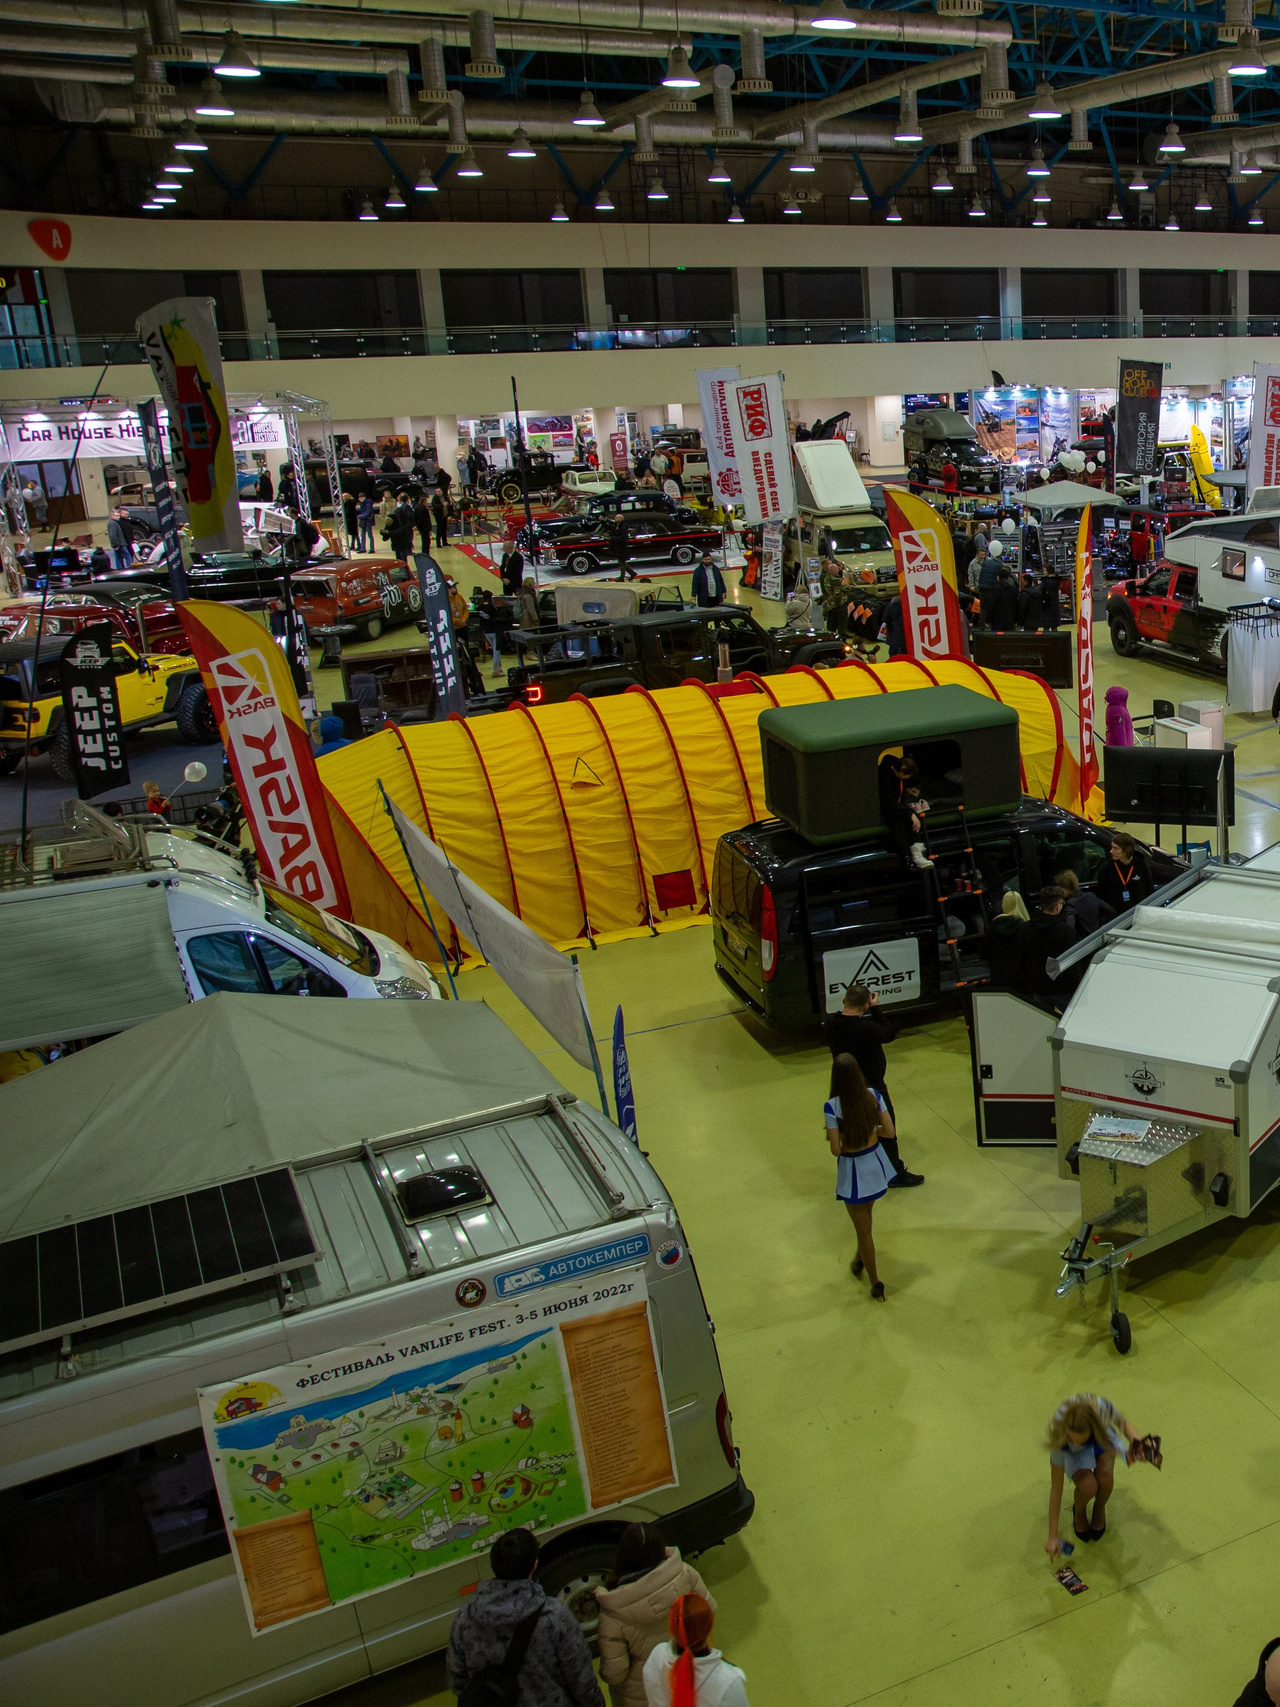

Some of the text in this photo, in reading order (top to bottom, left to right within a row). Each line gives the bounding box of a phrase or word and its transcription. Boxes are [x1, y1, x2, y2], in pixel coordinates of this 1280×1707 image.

[51, 229, 62, 248] A
[1122, 377, 1154, 389] ROAD
[1122, 387, 1147, 398] CLUB
[1124, 369, 1147, 381] OFF
[253, 423, 278, 433] HOUSE
[710, 381, 721, 433] тюнинг-центр
[742, 389, 766, 437] РИФ
[18, 422, 170, 442] CAR HOUSE HISO
[254, 431, 279, 443] HISTORY
[1136, 412, 1147, 471] ТЕРРИТОРИЯ
[1145, 422, 1156, 471] ОБЩЕНИЯ
[1263, 433, 1276, 486] ВНЕДОРОЖН
[751, 450, 769, 519] ВНЕДОРОЖНИК
[764, 451, 780, 513] СДЕЛАЙ СЕБЕ
[71, 686, 108, 772] JEEP
[100, 686, 123, 769] CUSTOM
[829, 970, 915, 994] EVEREST
[1065, 1087, 1109, 1100] EXPERT TRAIL
[548, 1239, 645, 1278] АВТОКЕМПЕР
[296, 1282, 635, 1390] ФЕСТИВАЛЬ VANLIFE FEST. 3-5 ИЮНЯ 2022г
